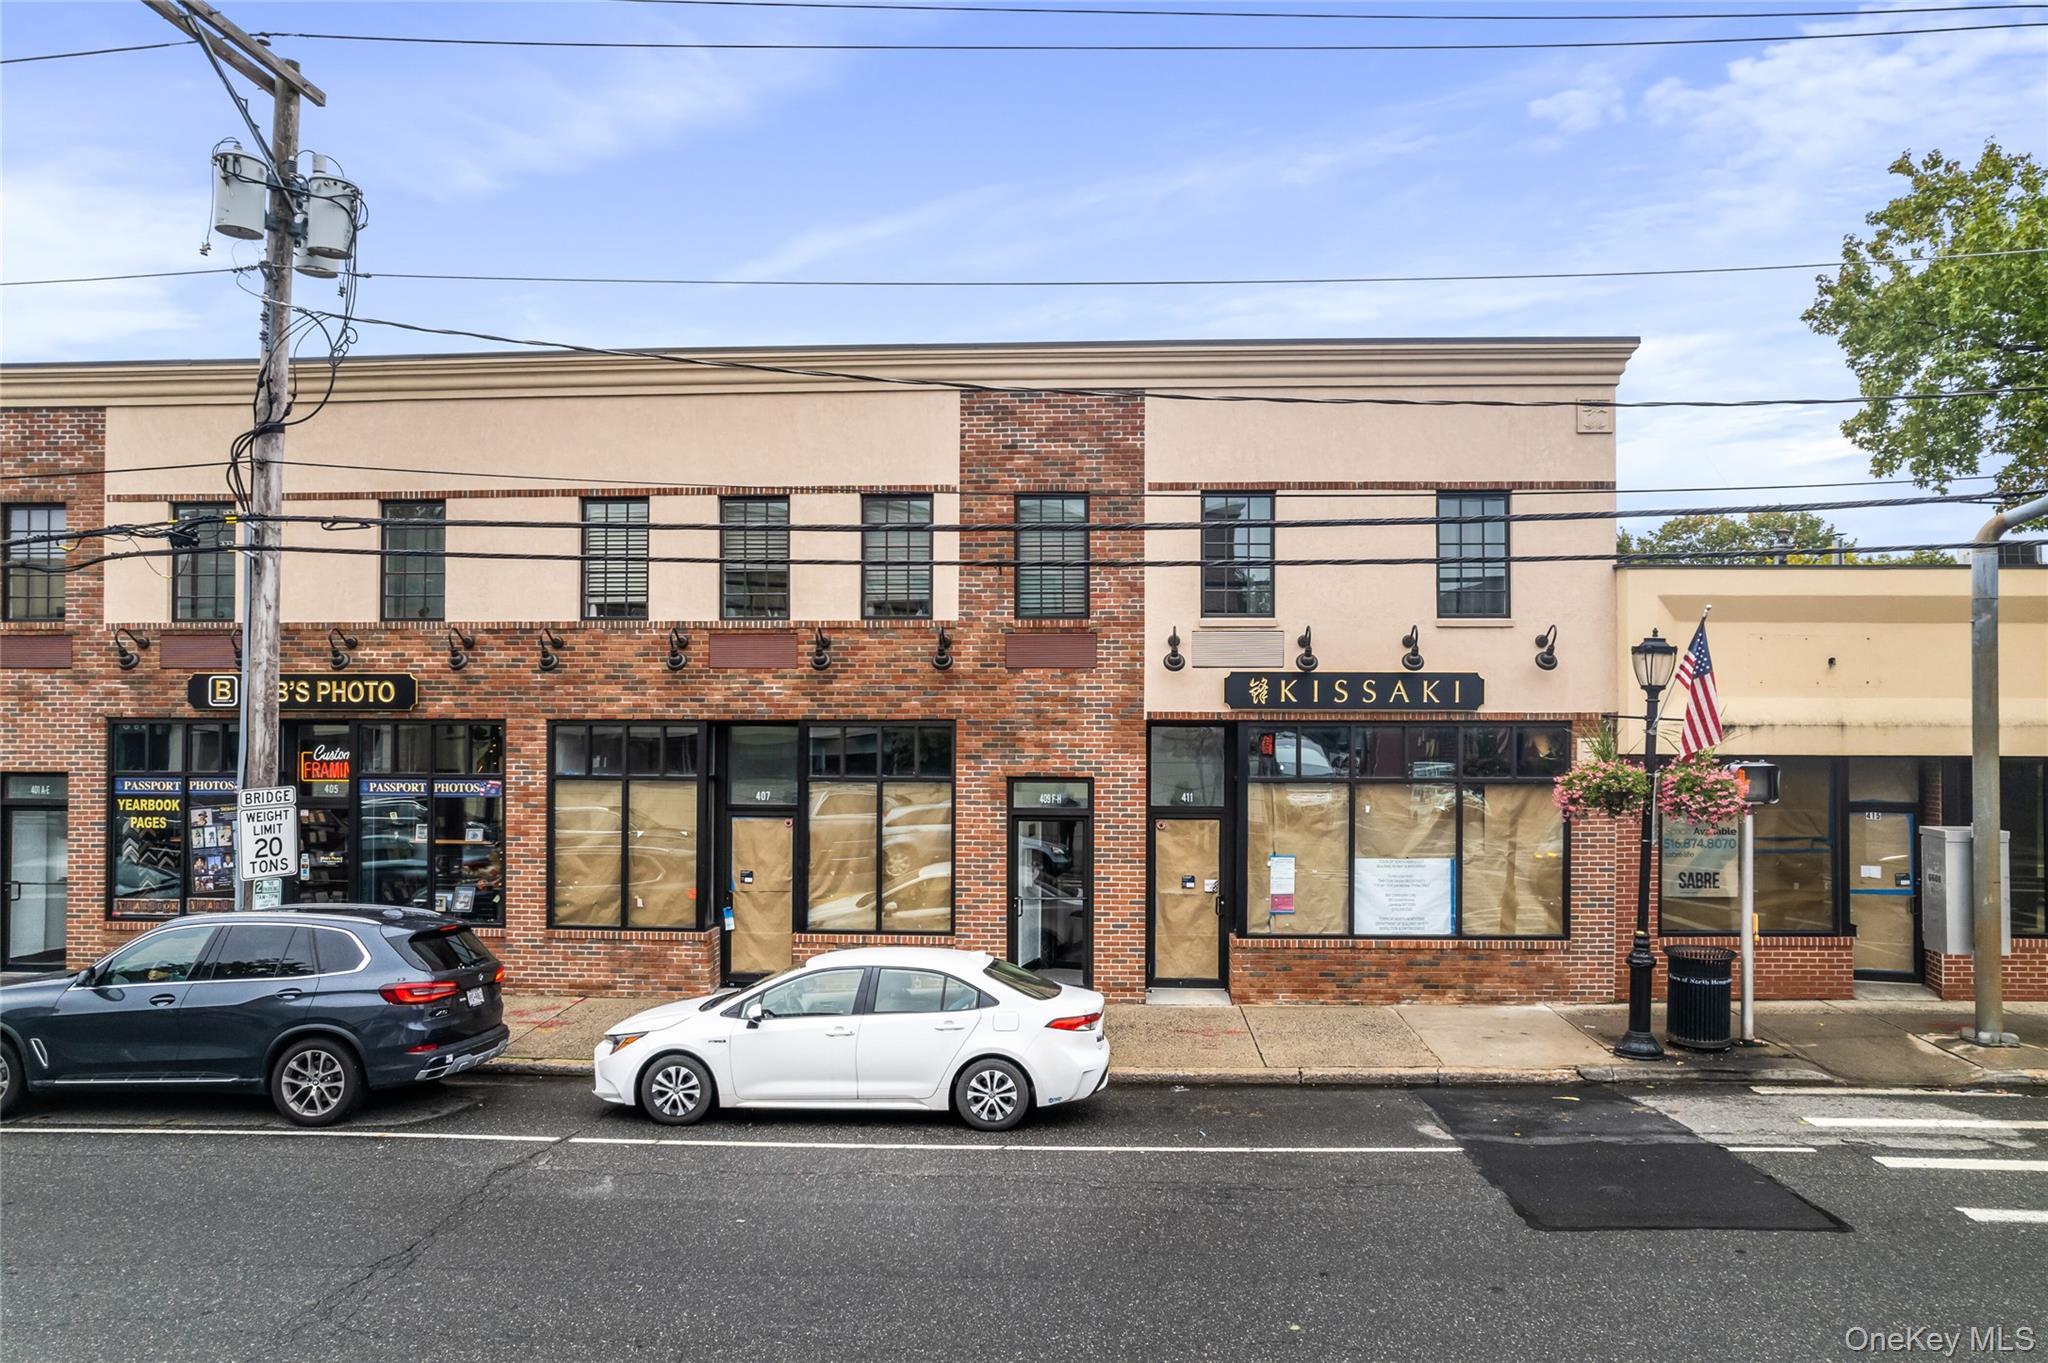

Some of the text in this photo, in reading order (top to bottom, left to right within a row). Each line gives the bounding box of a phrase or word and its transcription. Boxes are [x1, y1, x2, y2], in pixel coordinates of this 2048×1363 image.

[316, 681, 396, 703] PHOTO
[1280, 679, 1460, 704] KISSAKI
[304, 761, 349, 779] FRAMIN
[124, 780, 182, 791] PASSPORT
[323, 784, 339, 794] 405
[369, 782, 480, 793] PASSPORT PHOTOS
[244, 789, 291, 805] BRIDGE
[755, 791, 771, 801] 407
[1181, 792, 1193, 802] 411
[117, 798, 180, 811] YEARBOOK
[130, 816, 167, 829] PAGES
[246, 809, 290, 823] WEIGHT
[253, 823, 283, 836] LIMIT
[1693, 827, 1737, 836] Avable
[254, 836, 283, 859] 20
[250, 858, 289, 875] TONS
[1678, 871, 1720, 889] SABRE
